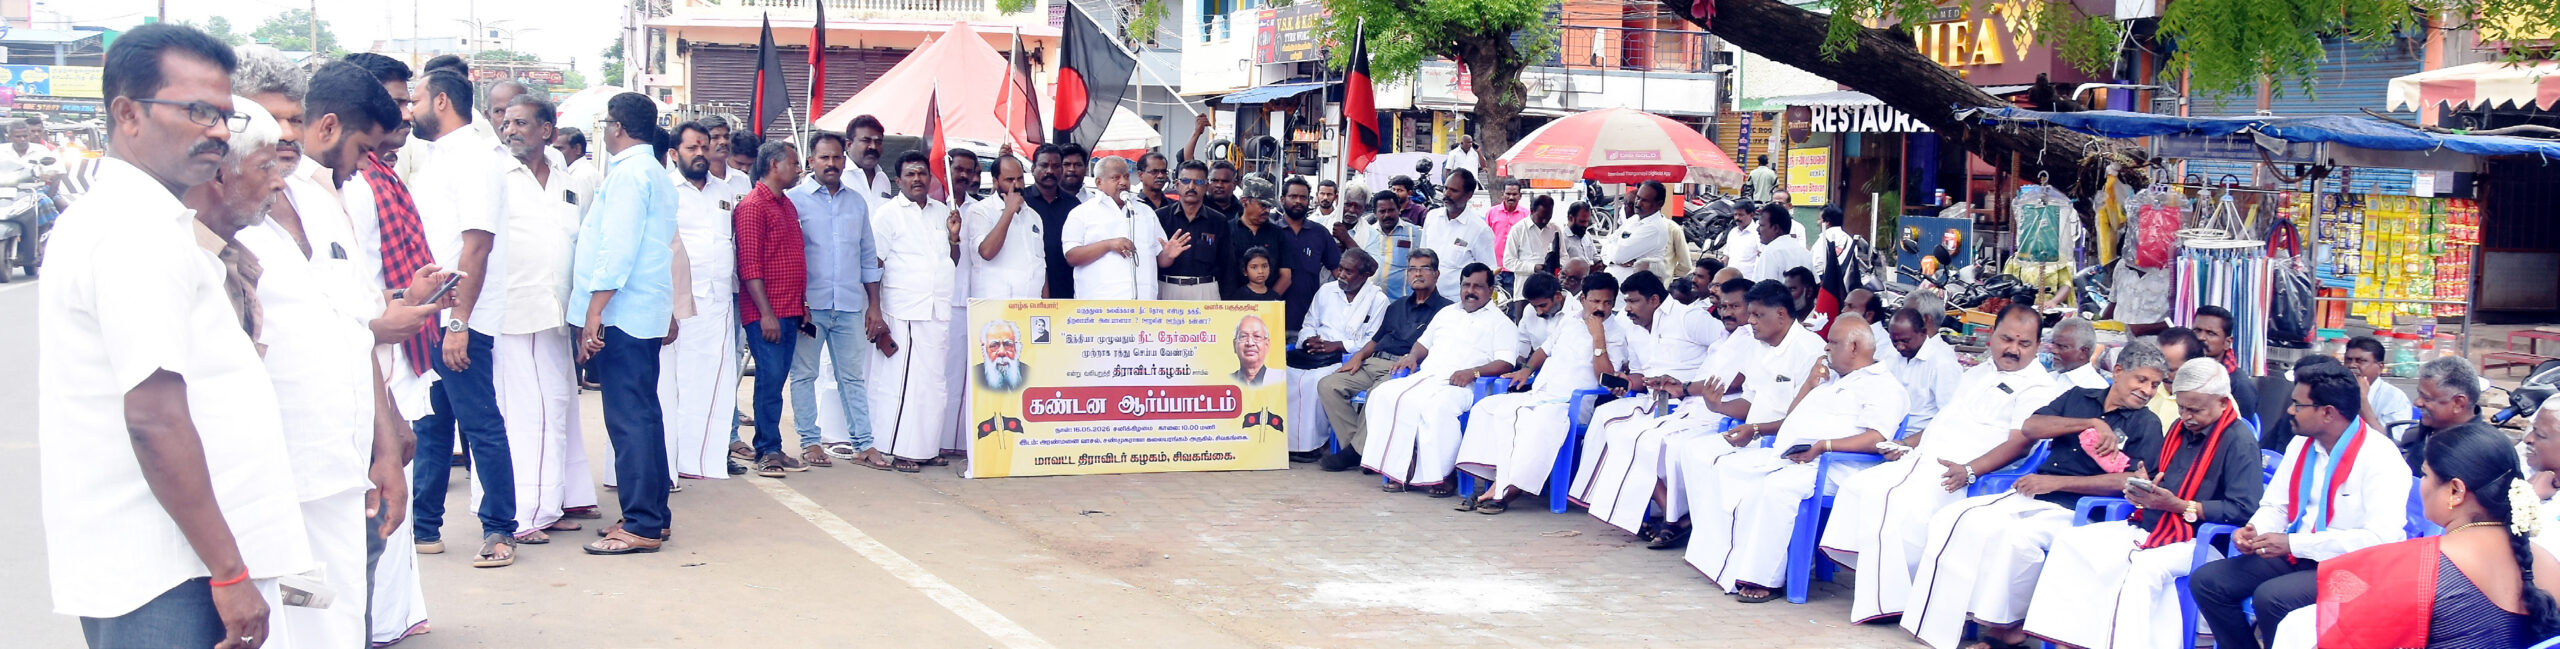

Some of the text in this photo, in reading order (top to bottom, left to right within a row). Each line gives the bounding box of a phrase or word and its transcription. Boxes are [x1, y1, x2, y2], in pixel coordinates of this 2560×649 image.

[1811, 105, 1935, 133] RESTAURA
[1138, 330, 1154, 344] நீட்
[1157, 330, 1217, 344] தேர்வையே
[1029, 389, 1237, 417] கண்டன ஆர்ப்பாட்டம்
[1035, 449, 1236, 466] மாவட்ட திராவிடர் கழகம், சிவகங்கை.
